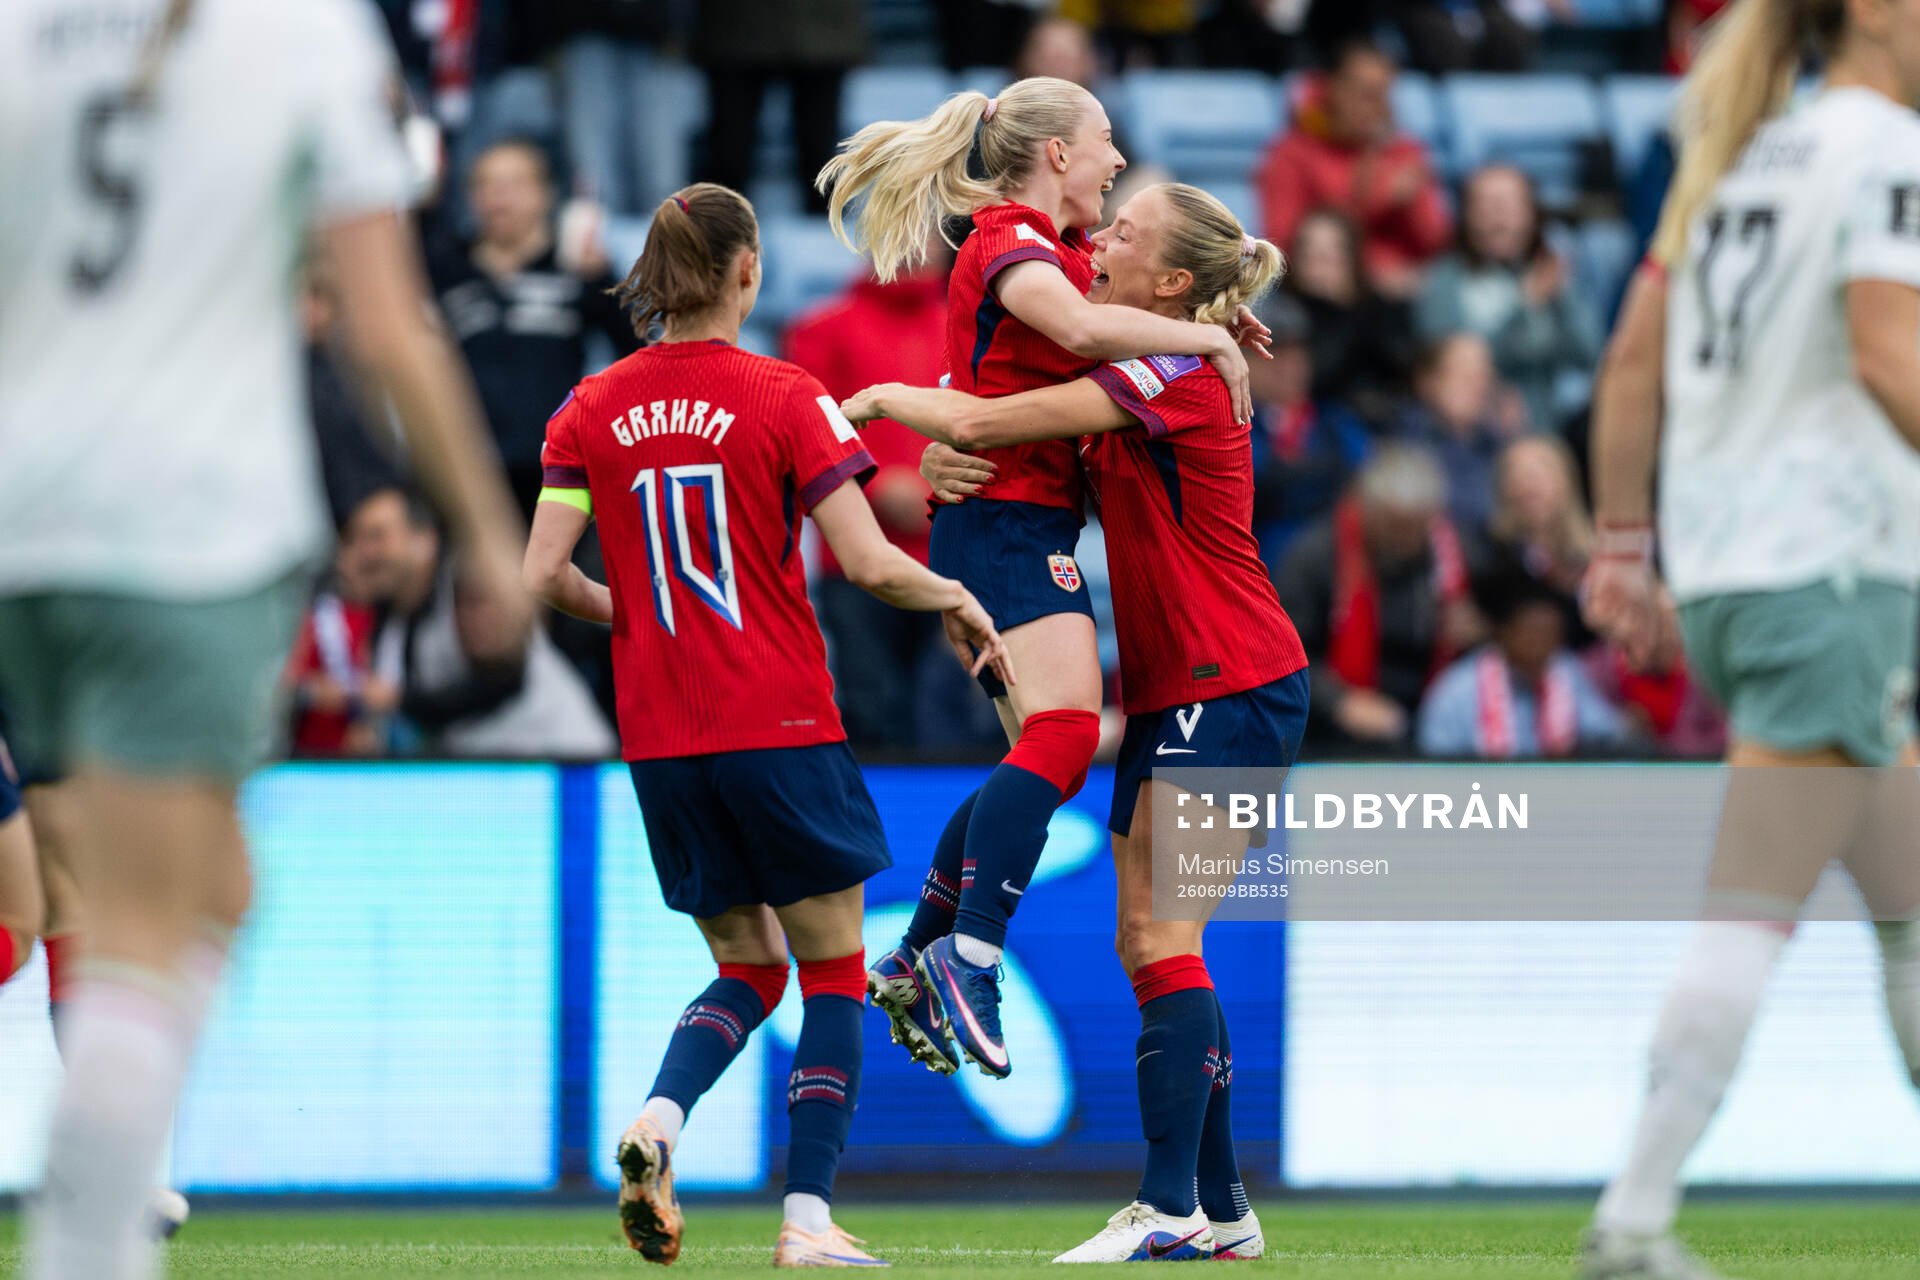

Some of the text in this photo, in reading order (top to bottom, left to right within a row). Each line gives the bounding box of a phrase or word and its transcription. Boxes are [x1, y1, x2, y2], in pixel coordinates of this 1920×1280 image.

[67, 88, 156, 295] 5
[1694, 207, 1777, 371] 17
[610, 398, 736, 447] GRAHAM
[629, 463, 743, 638] 10
